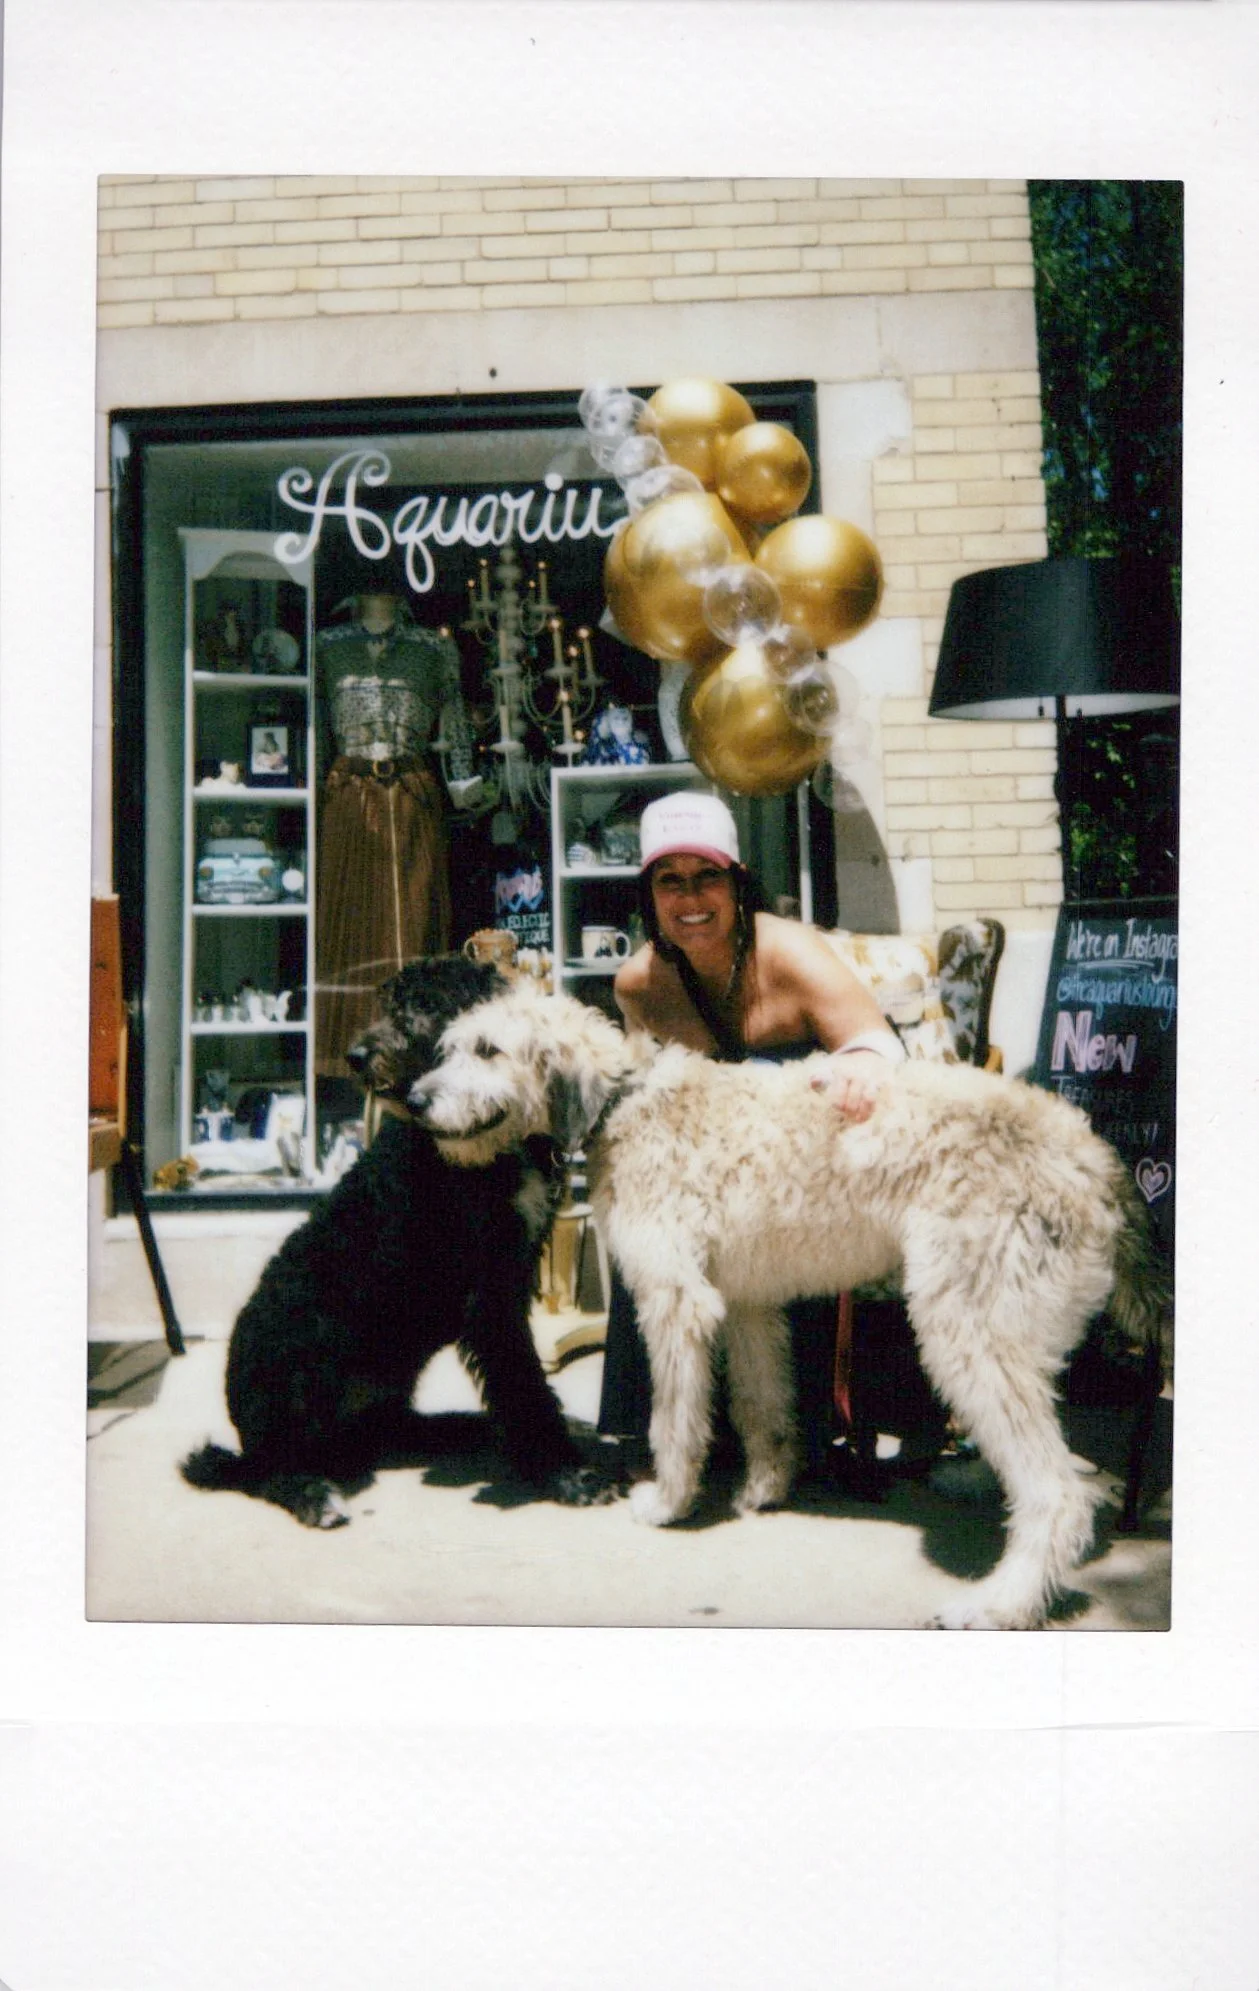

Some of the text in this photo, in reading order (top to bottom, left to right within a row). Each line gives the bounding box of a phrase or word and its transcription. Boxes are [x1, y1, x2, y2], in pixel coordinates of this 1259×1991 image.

[274, 449, 632, 593] Aquariu
[1066, 919, 1103, 960] We're
[1104, 932, 1120, 958] on
[1051, 1010, 1138, 1073] New
